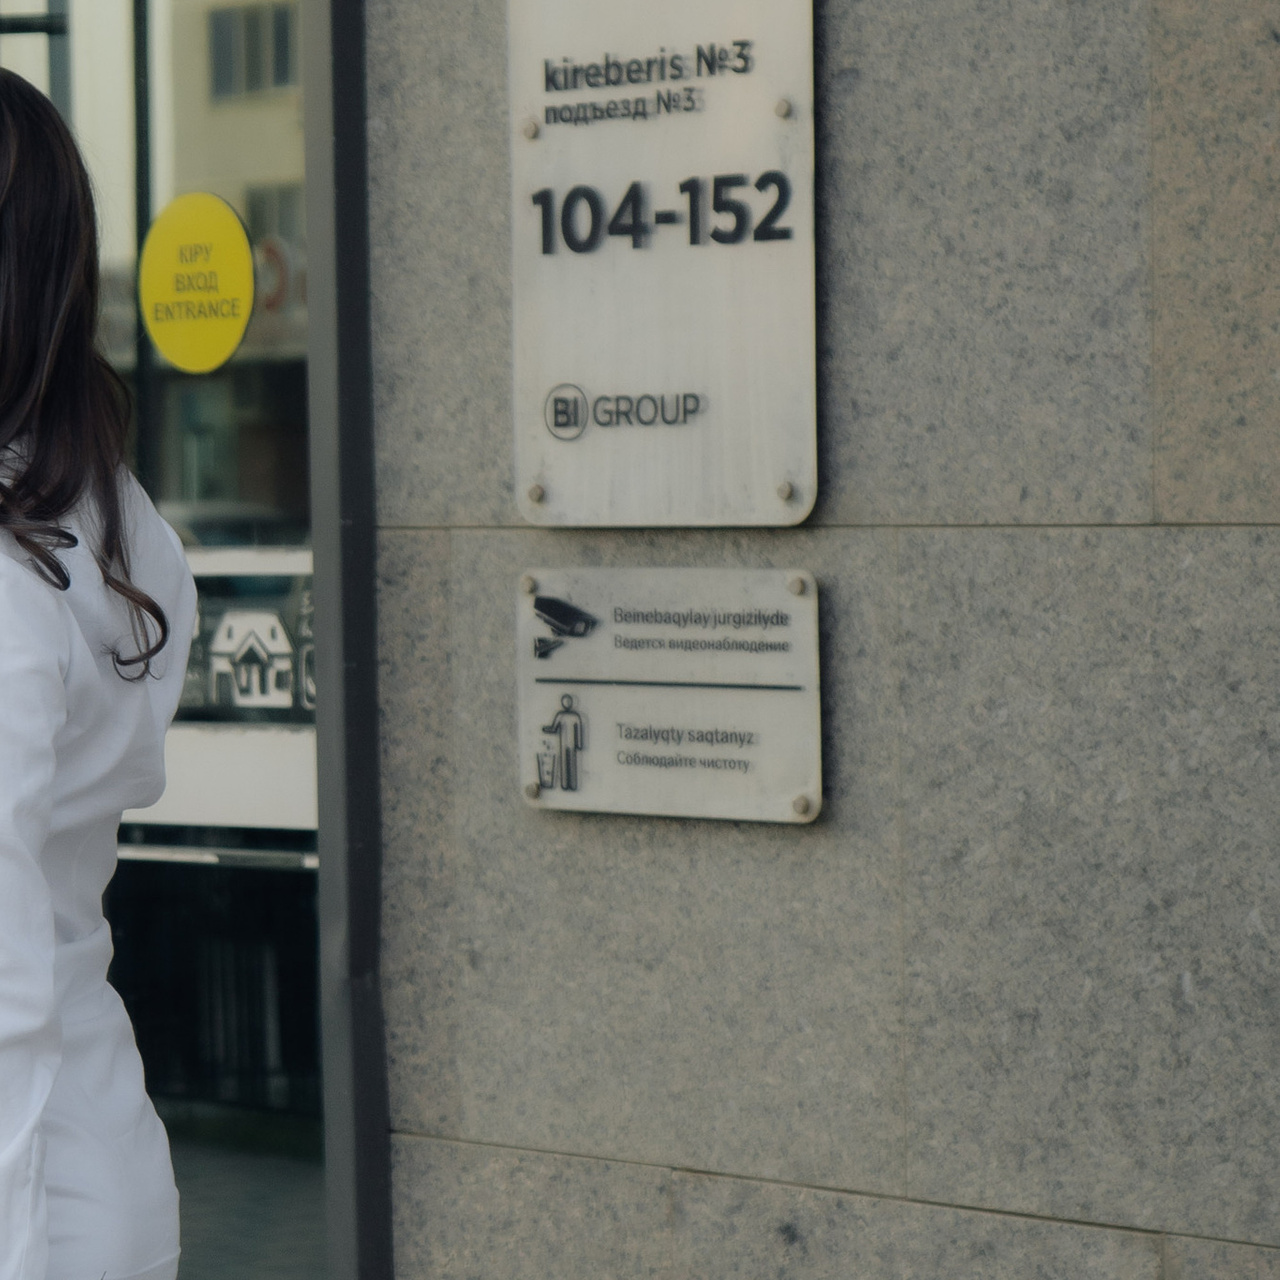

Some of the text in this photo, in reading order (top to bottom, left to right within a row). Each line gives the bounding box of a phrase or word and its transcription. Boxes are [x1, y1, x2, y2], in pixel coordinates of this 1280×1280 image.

[544, 46, 685, 92] kireberis
[545, 94, 647, 126] подъезд
[531, 170, 794, 255] 104-152
[175, 271, 220, 294] ВХОД
[153, 297, 241, 322] ENTRANCE
[553, 393, 702, 427] BI GROUP
[614, 634, 790, 653] Ведется видеонаблюдение
[616, 722, 684, 746] Tazalyqty
[616, 750, 751, 774] Соблюдайте чистоту
